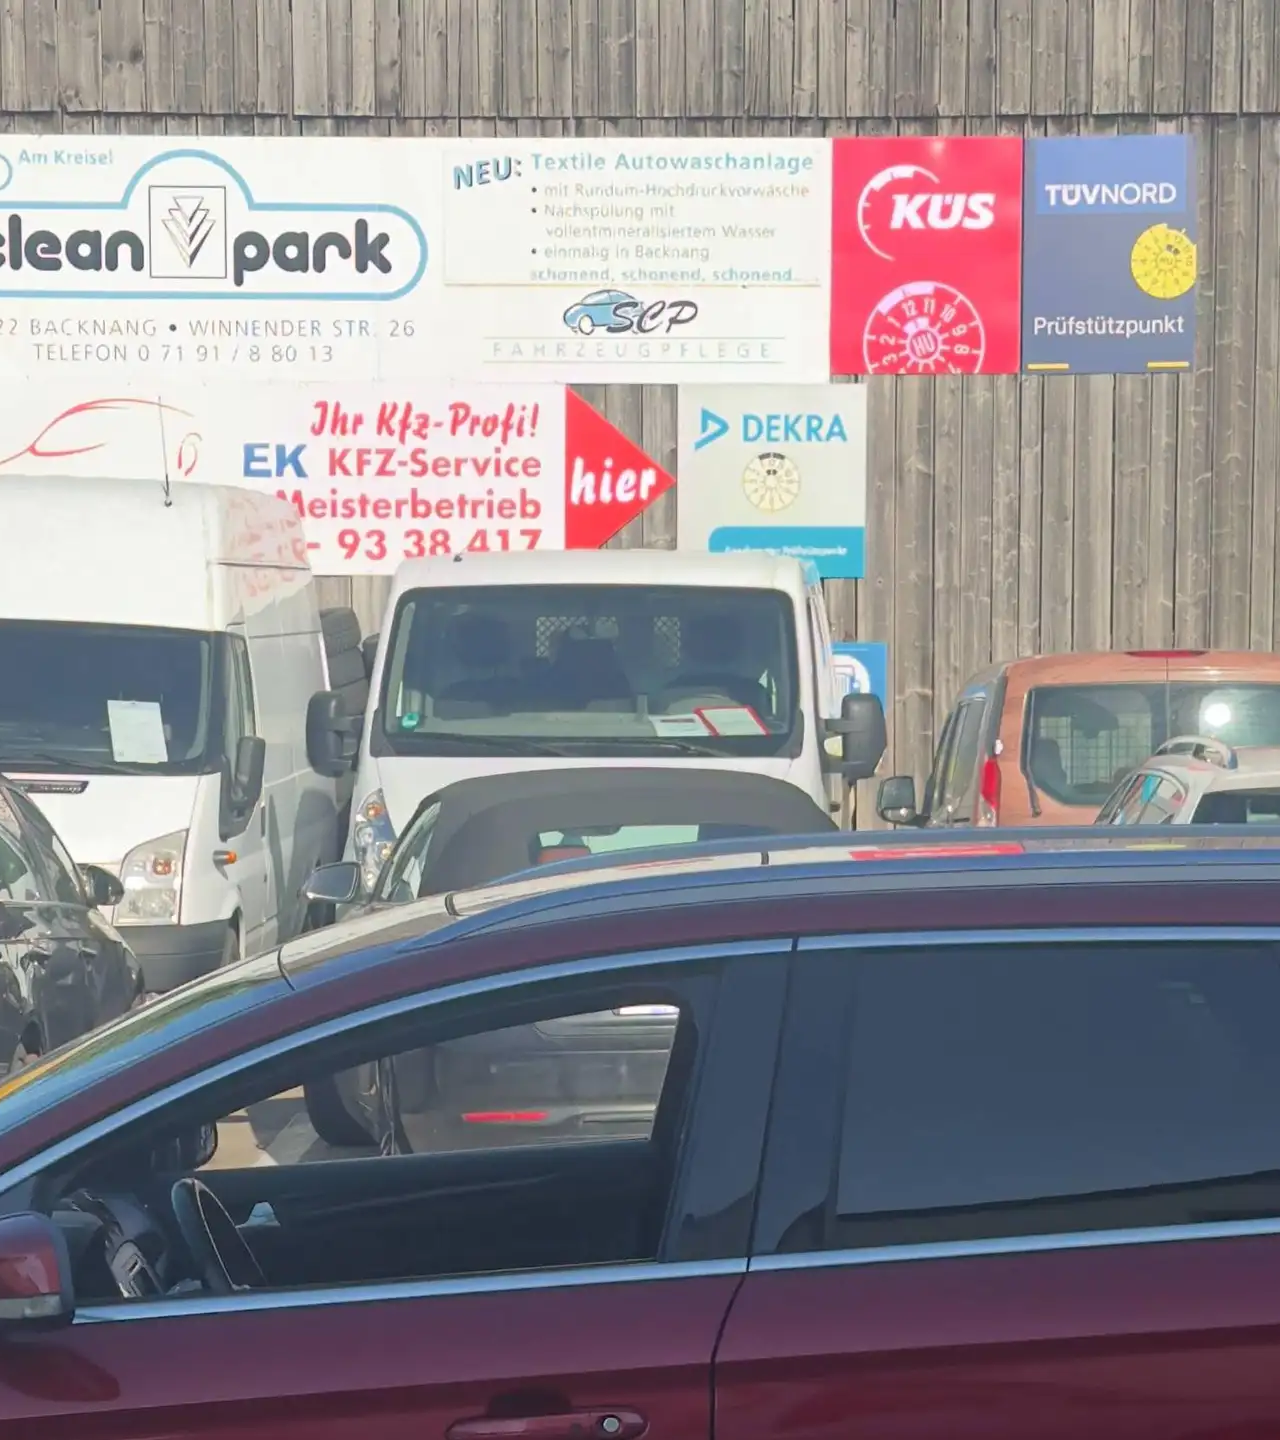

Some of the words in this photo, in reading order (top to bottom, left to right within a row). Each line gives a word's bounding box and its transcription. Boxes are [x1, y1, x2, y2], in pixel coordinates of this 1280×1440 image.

[18, 149, 48, 165] Am
[53, 148, 114, 165] Kreisel
[531, 153, 606, 171] Textile
[614, 152, 814, 175] Autowaschanlage
[453, 155, 522, 190] NEU:
[544, 182, 569, 198] mit
[544, 203, 645, 221] Nachspülung
[650, 203, 675, 218] mit
[889, 192, 996, 230] KÜS
[545, 224, 716, 239] vollentmineralisiertem
[721, 224, 776, 239] Wasser
[233, 217, 393, 287] park
[544, 243, 610, 262] einmalig
[616, 244, 630, 259] in
[635, 244, 710, 263] Backnang
[29, 318, 157, 337] BACKNANG
[188, 318, 322, 338] WINNENDER
[388, 319, 415, 338] 26
[605, 299, 699, 335] SCP
[1033, 314, 1185, 339] Prüfstützpunkt
[34, 343, 128, 362] TELEFON
[138, 344, 150, 362] 0
[161, 344, 183, 362] 71
[196, 344, 220, 363] 91
[248, 345, 261, 363] 8
[271, 345, 298, 363] 80
[309, 345, 333, 363] 13
[493, 341, 771, 360] FAHRZEUGPFLEGE
[310, 400, 365, 436] Ihr
[376, 401, 540, 446] Kfz-Profi!
[742, 413, 848, 443] DEKRA
[242, 442, 309, 479] EK
[327, 446, 542, 478] KFZ-Service
[570, 455, 657, 505] hier
[337, 528, 388, 561] 93
[403, 528, 451, 558] 38
